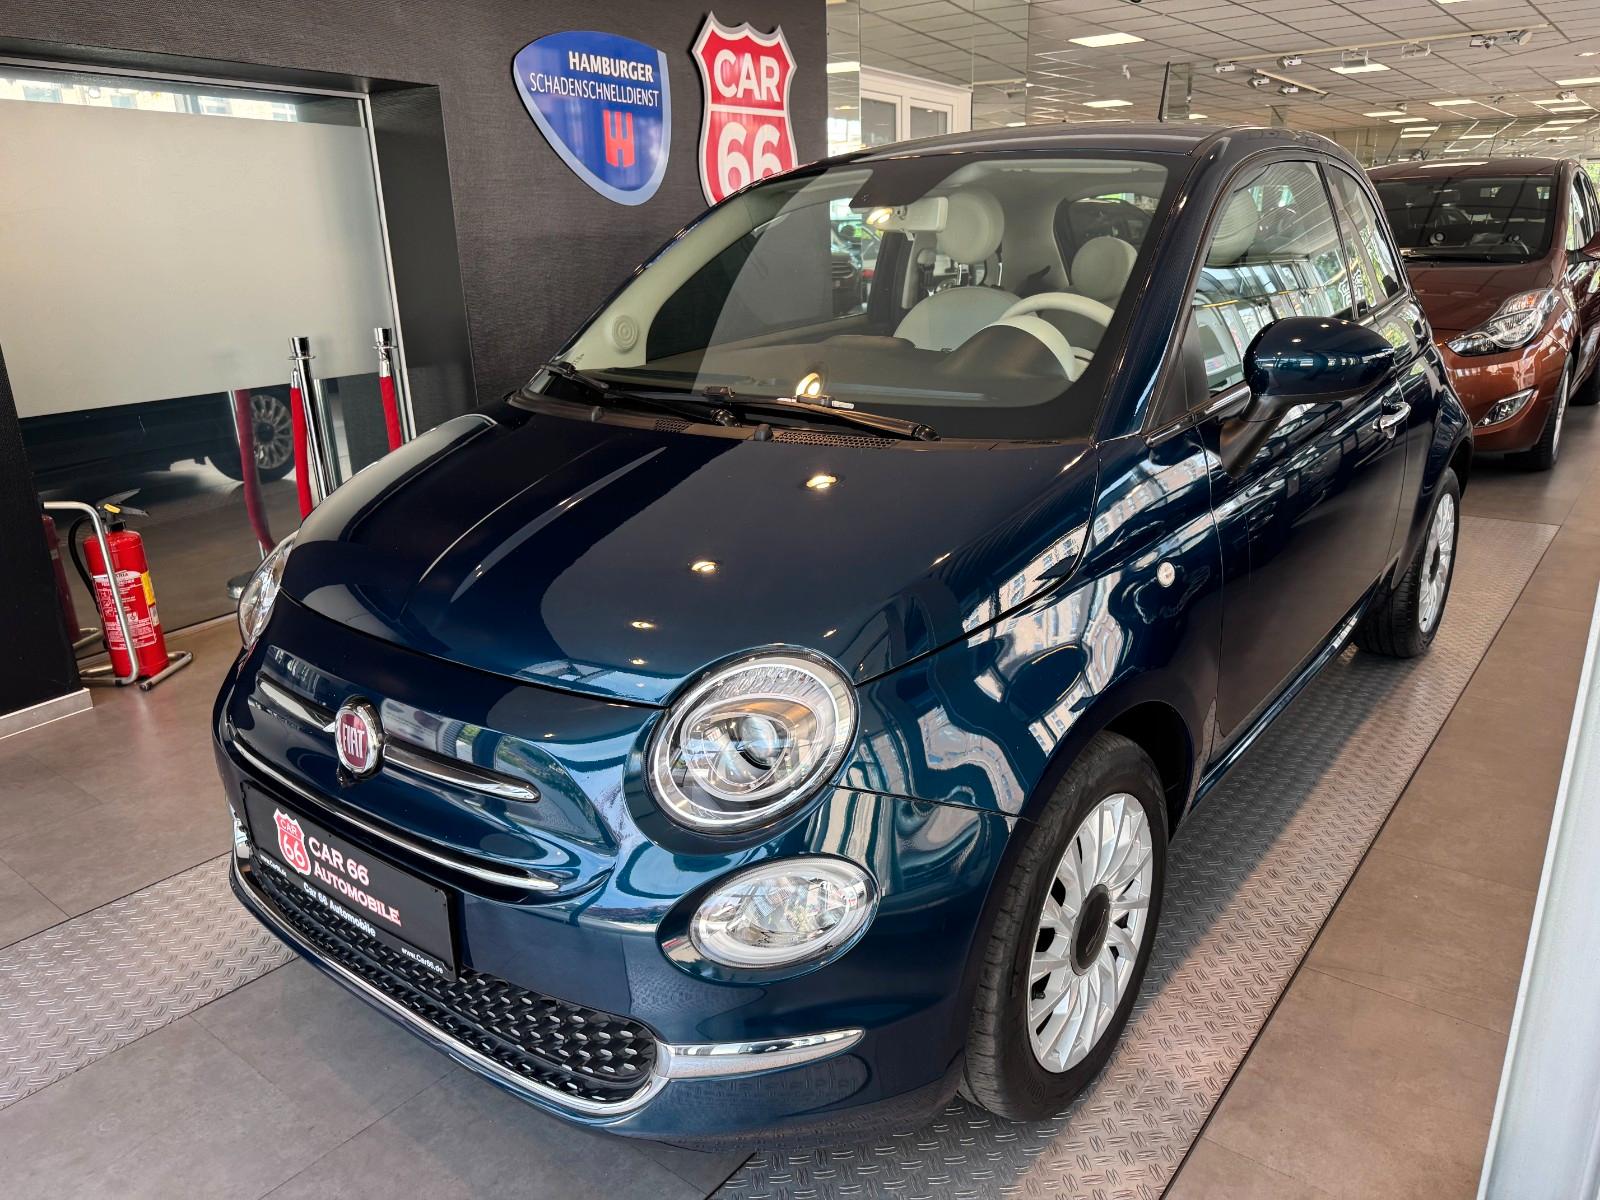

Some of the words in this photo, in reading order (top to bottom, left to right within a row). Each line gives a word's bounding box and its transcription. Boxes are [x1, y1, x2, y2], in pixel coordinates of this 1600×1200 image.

[568, 50, 654, 82] HAMBURGER
[713, 49, 781, 102] CAR
[530, 72, 660, 107] SCHADENSCHNELLDIENST
[717, 121, 781, 201] 66
[342, 722, 365, 759] FIAT
[280, 819, 298, 836] CAR
[283, 833, 306, 868] 66
[308, 836, 345, 874] CAR
[346, 858, 370, 886] 66
[303, 881, 317, 898] Car
[329, 899, 376, 938] Automobile
[313, 860, 402, 927] AUTOMOBILE
